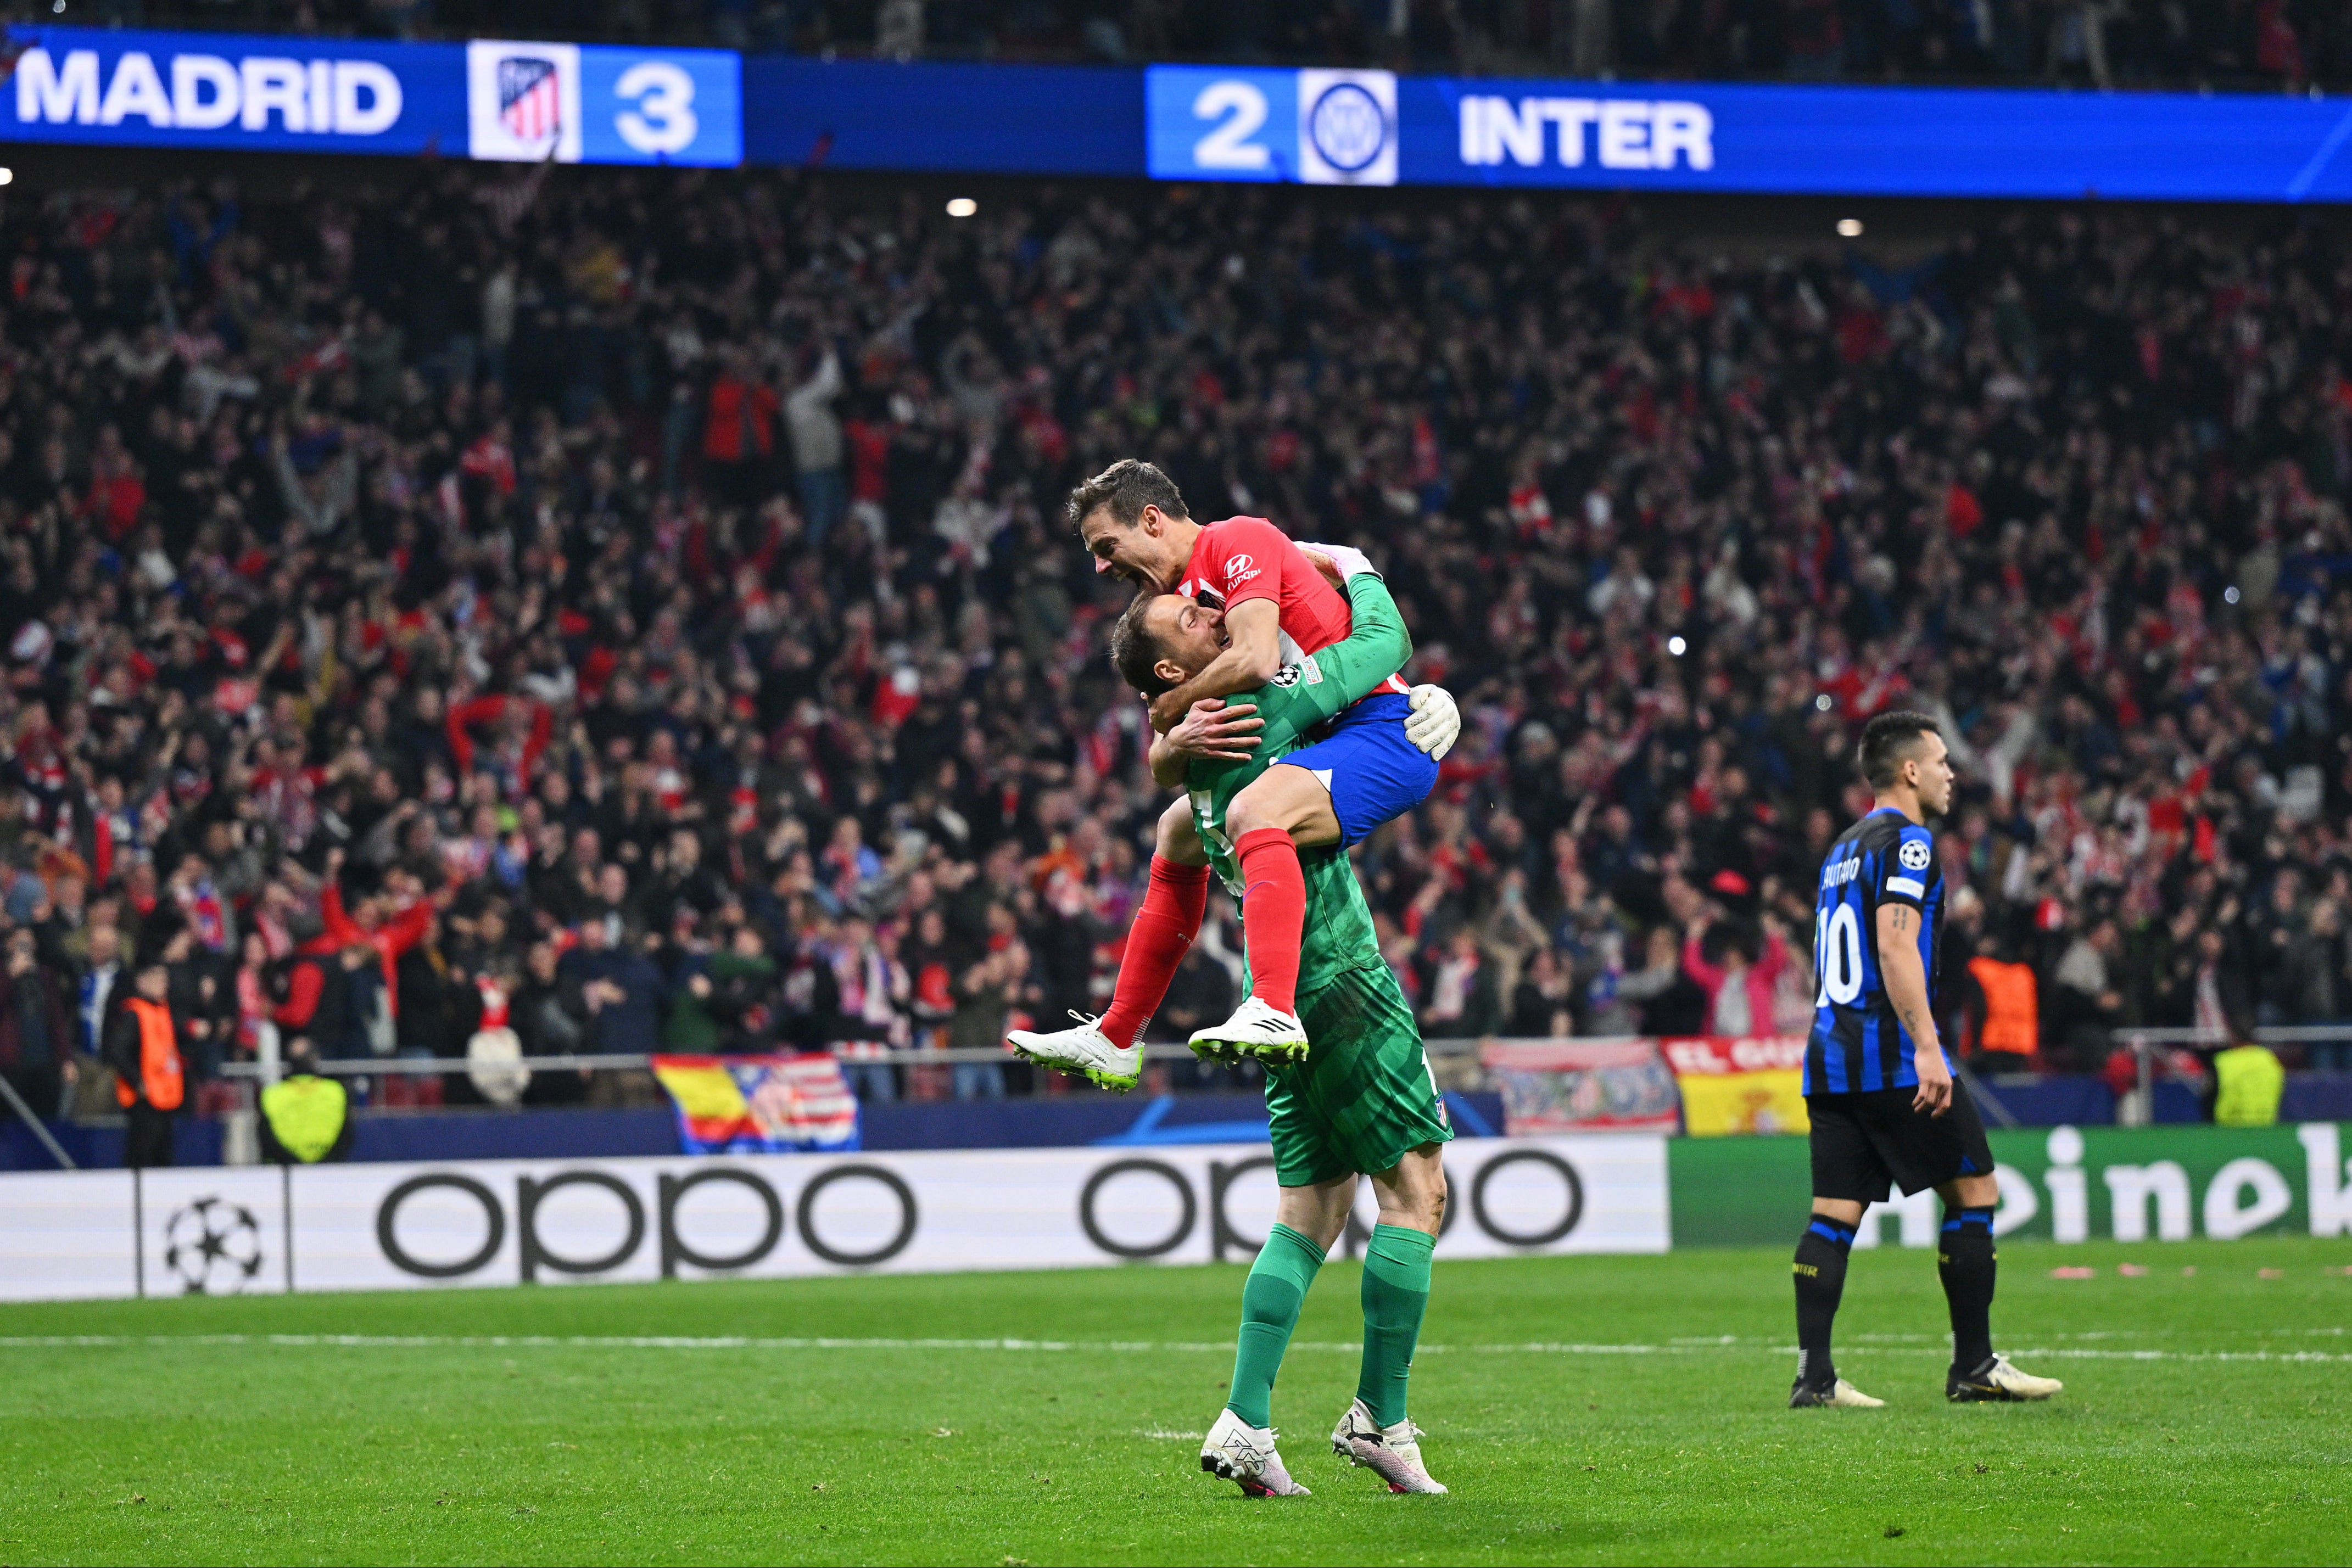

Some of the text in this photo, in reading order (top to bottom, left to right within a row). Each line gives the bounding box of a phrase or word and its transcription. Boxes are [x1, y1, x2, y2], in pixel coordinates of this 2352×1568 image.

[15, 48, 700, 154] MADRID 3
[1192, 81, 1714, 171] 2 INTER
[1822, 856, 1861, 891] AUTARO
[1815, 902, 1863, 1007] 10
[377, 1162, 918, 1284] oppo
[1792, 1263, 1818, 1278] NTER
